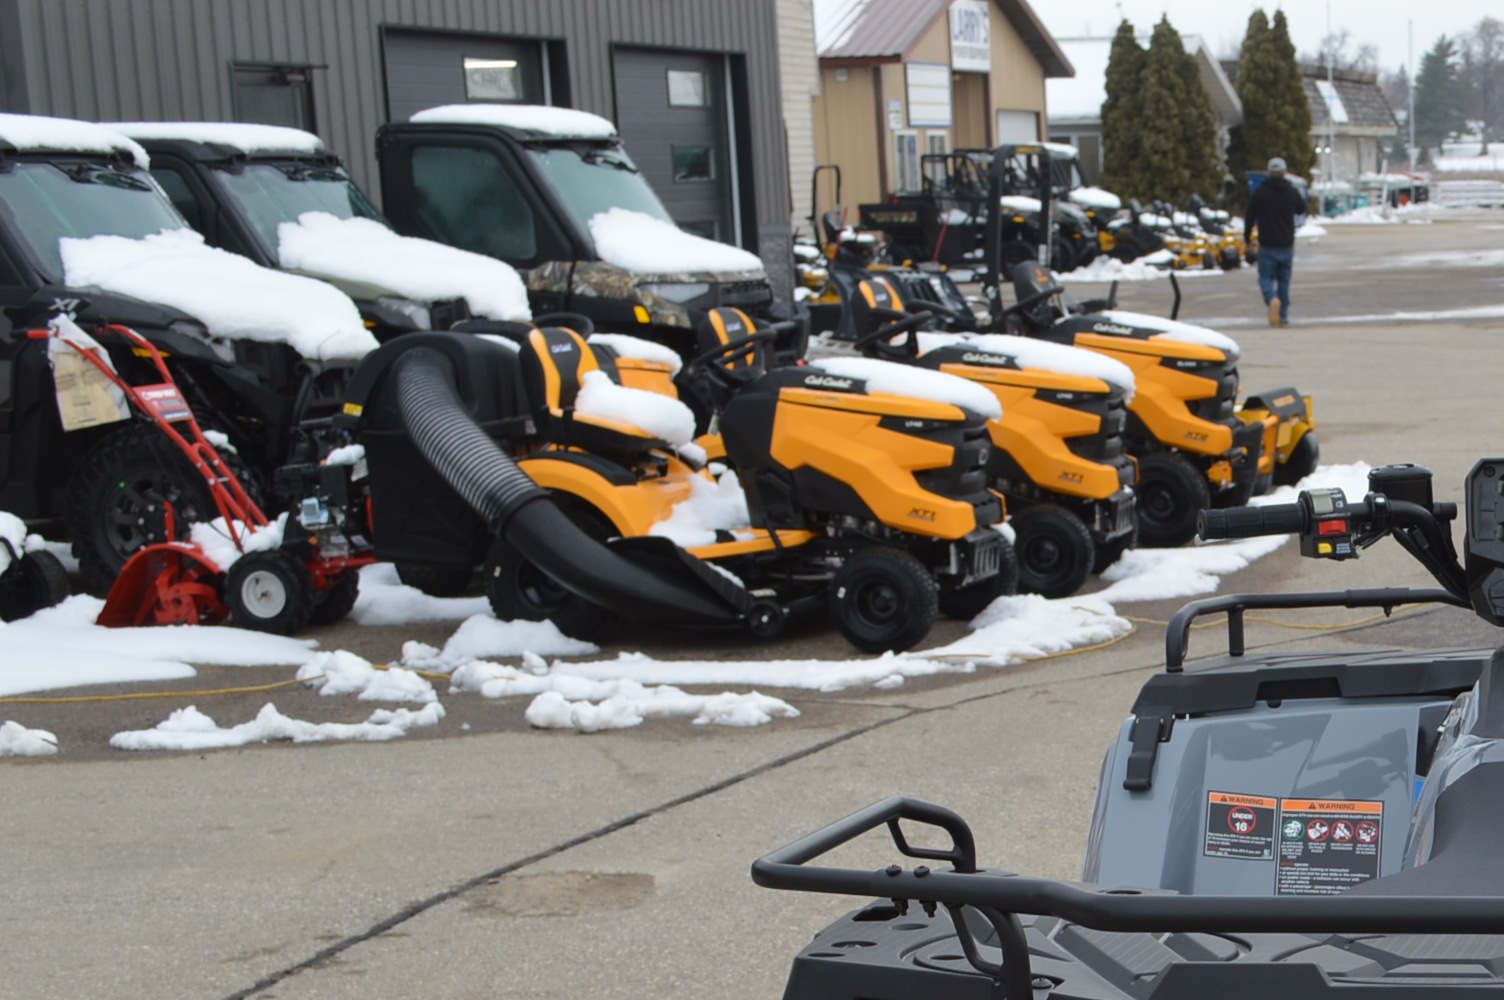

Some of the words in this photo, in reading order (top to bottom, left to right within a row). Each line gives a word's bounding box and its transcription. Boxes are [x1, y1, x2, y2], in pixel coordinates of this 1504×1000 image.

[1228, 796, 1264, 806] WARNING
[1232, 812, 1253, 820] UNDER
[1234, 822, 1248, 832] 16
